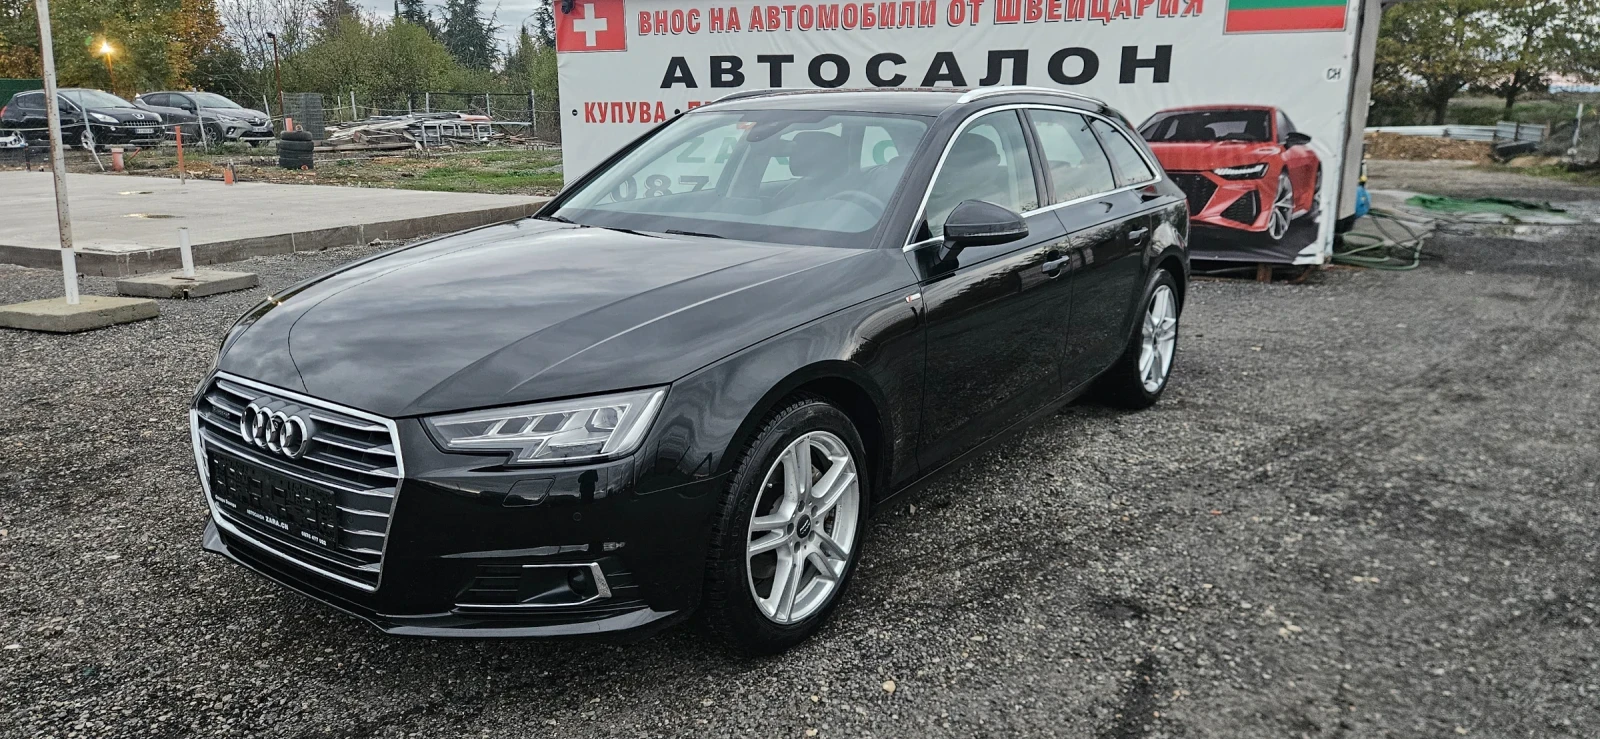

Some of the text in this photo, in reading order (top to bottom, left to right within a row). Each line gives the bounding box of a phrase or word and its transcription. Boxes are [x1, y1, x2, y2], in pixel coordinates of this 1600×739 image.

[638, 8, 701, 36] ВНОС
[708, 6, 741, 33] НА
[748, 0, 937, 32] АВТОМОБИЛИ
[946, 0, 985, 27] ОТ
[660, 44, 1173, 89] АВТОСАЛОН
[584, 101, 667, 124] КУПУВА
